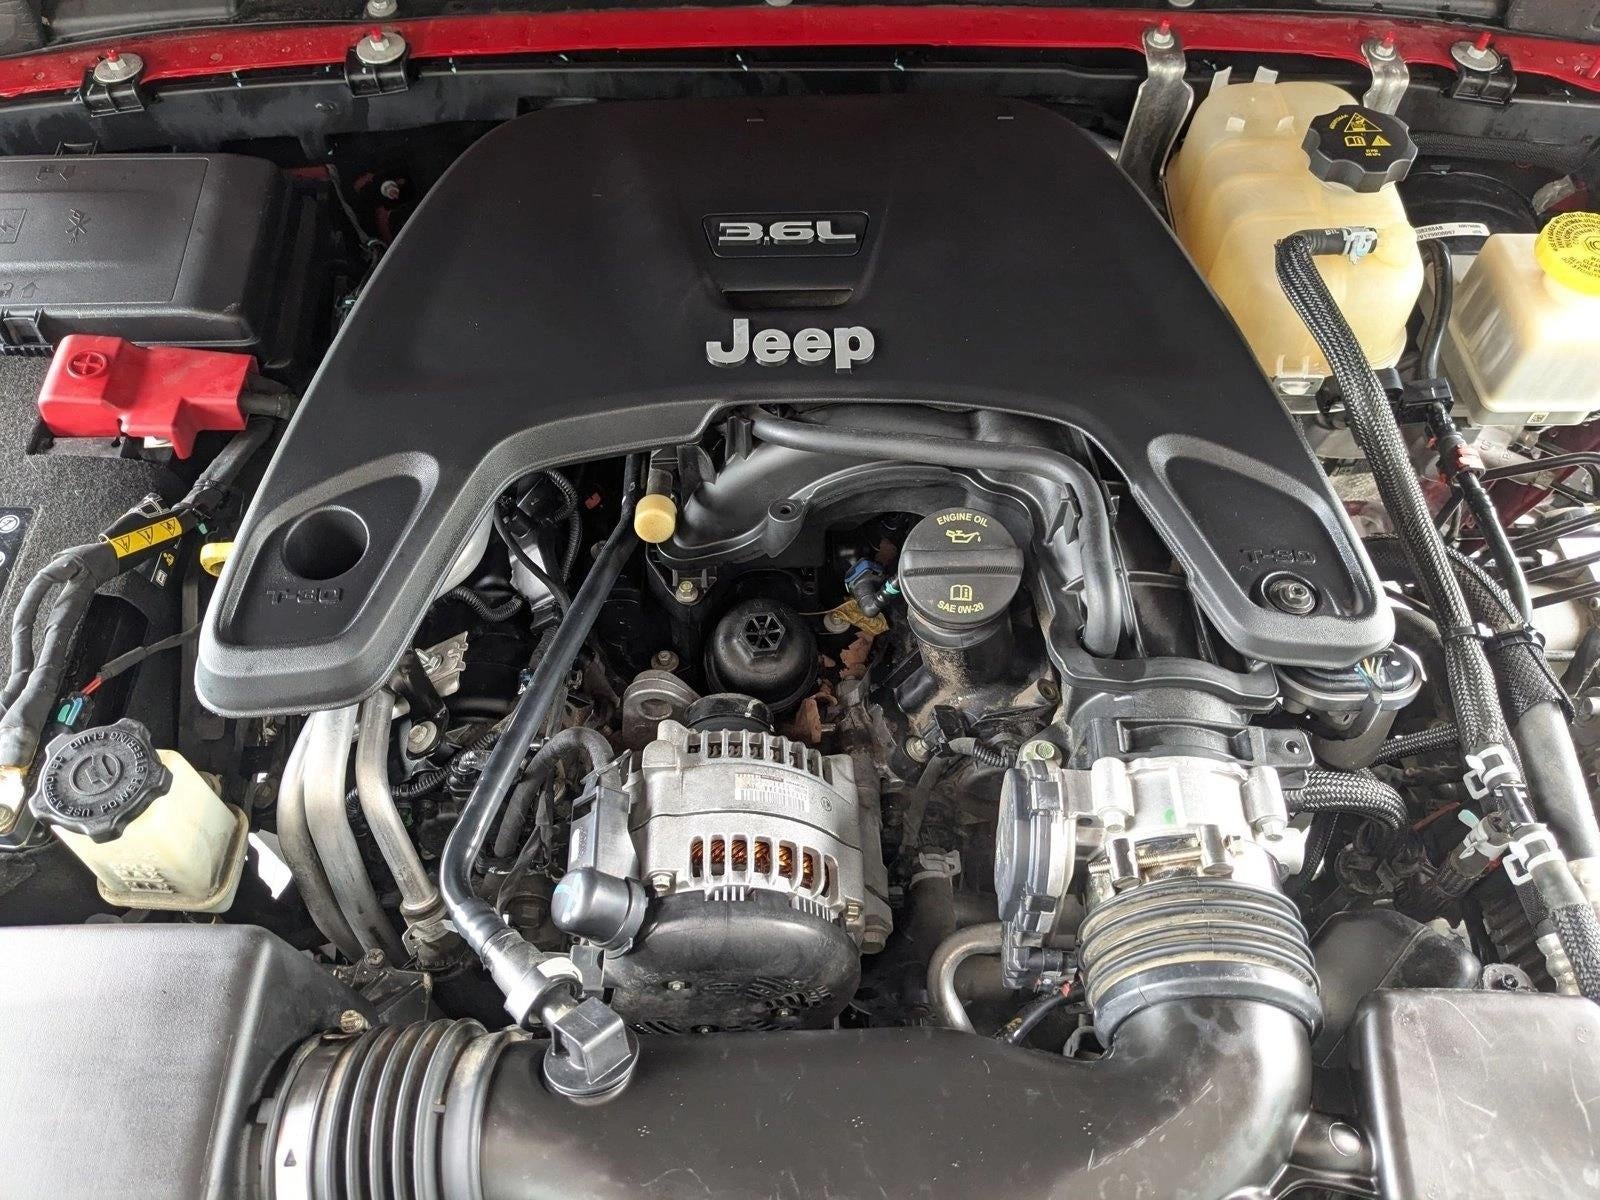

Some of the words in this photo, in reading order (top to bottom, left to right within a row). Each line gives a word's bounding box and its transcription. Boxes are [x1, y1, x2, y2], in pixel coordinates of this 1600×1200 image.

[718, 220, 856, 245] 3.6L
[706, 318, 875, 373] Jeep
[936, 512, 972, 525] ENGINE
[973, 515, 988, 527] OIL
[937, 600, 956, 613] SAE
[957, 602, 984, 613] 0W-20
[109, 731, 148, 774] STEERING
[100, 777, 141, 813] POWER
[66, 806, 93, 816] USE
